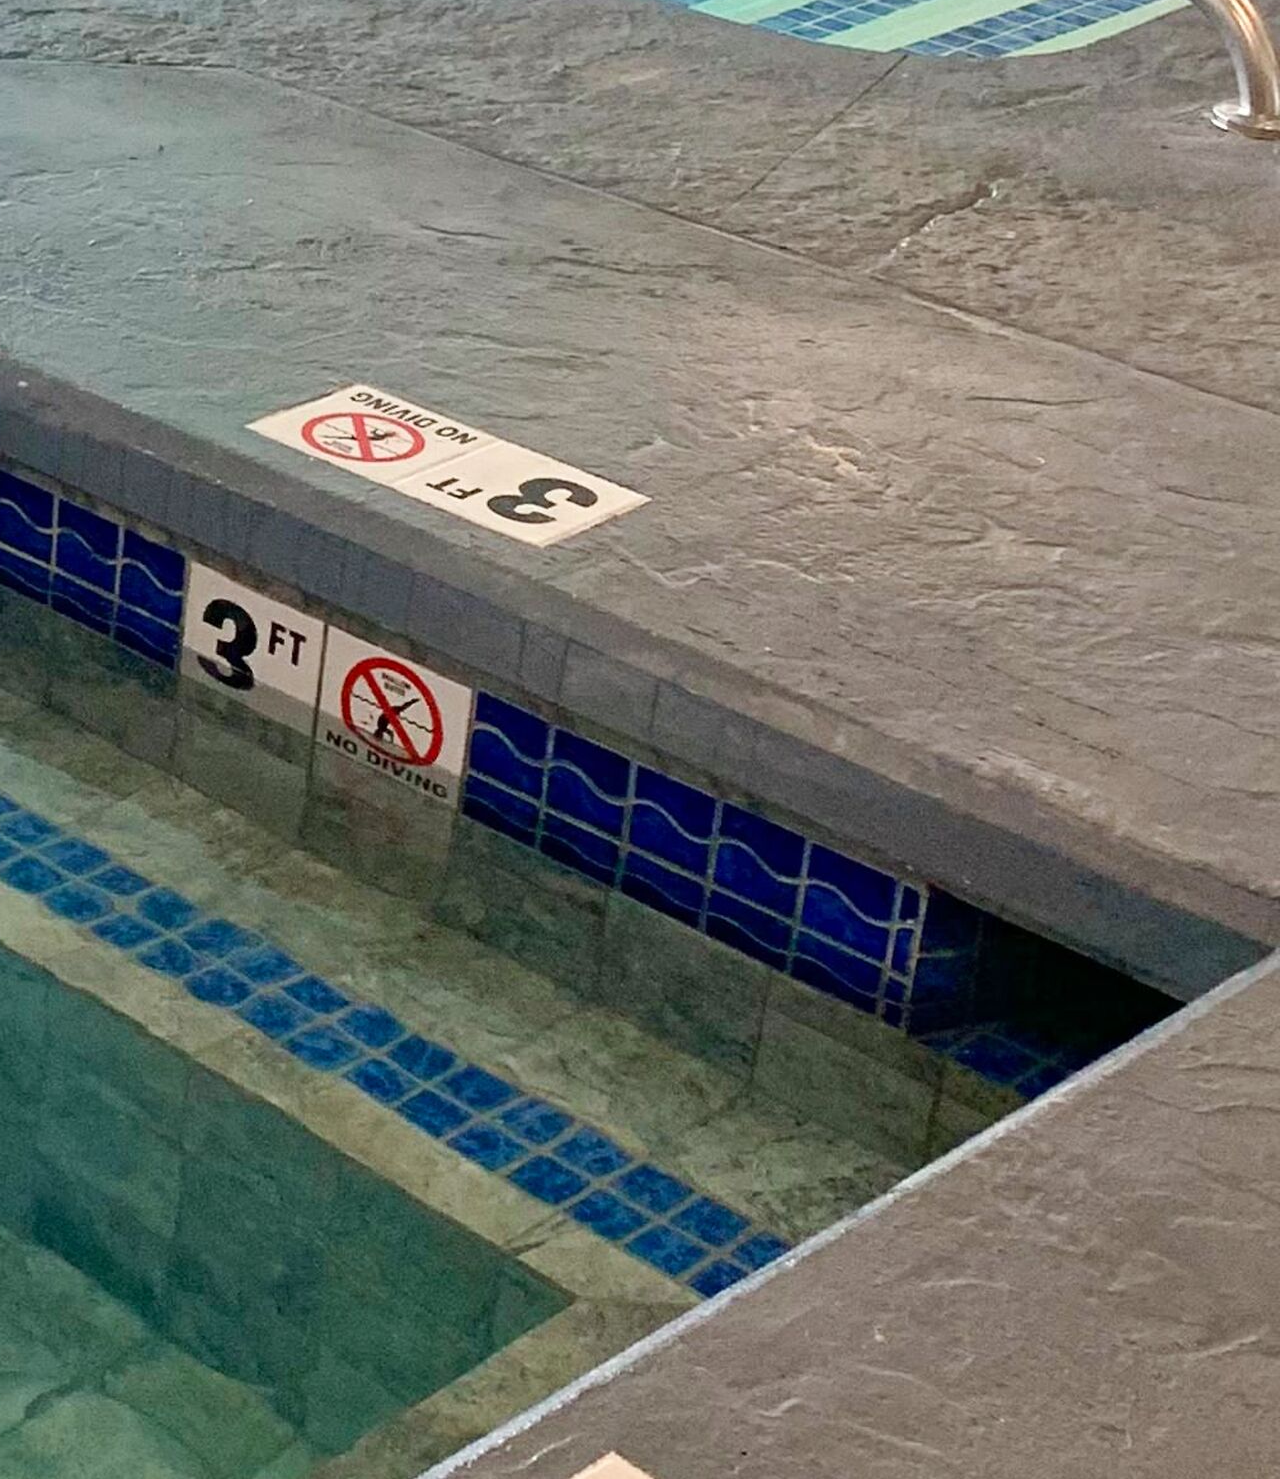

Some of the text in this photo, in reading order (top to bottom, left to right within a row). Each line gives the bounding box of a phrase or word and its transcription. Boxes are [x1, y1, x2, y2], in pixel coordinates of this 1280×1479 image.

[350, 392, 478, 445] NO DIVING
[425, 477, 599, 524] 3 FT
[197, 598, 307, 691] 3 FT
[326, 729, 448, 798] NO DIVING
